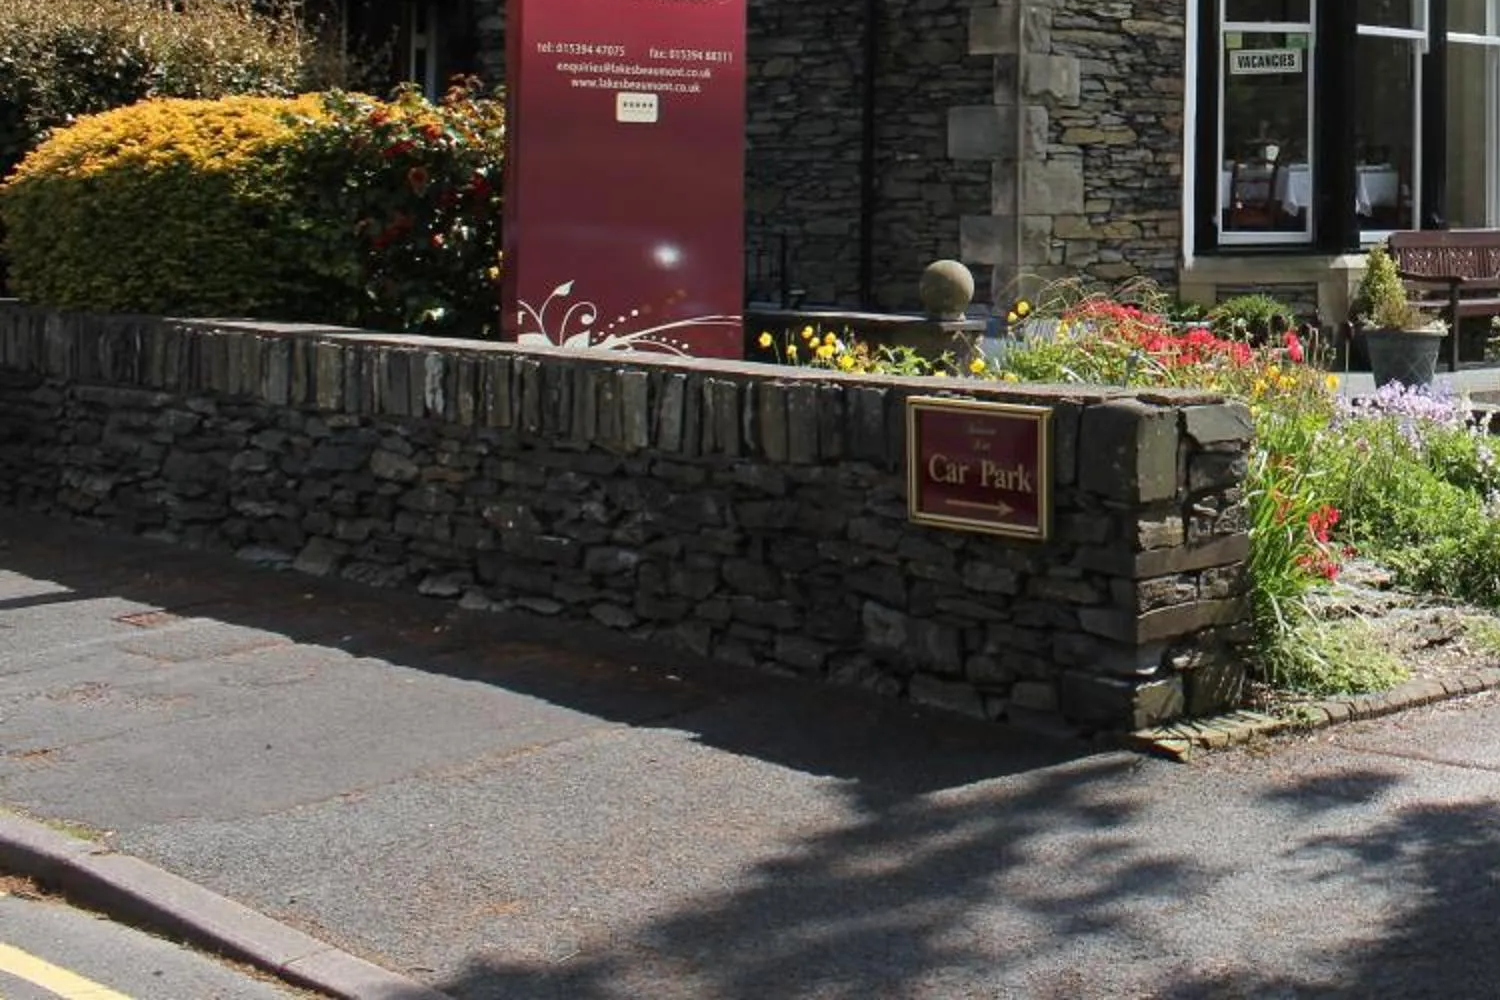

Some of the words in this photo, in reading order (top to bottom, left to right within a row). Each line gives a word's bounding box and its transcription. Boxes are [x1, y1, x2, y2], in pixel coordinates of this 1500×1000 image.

[1236, 53, 1296, 69] VACANCIES
[928, 453, 969, 485] Car
[979, 458, 1033, 494] Park
